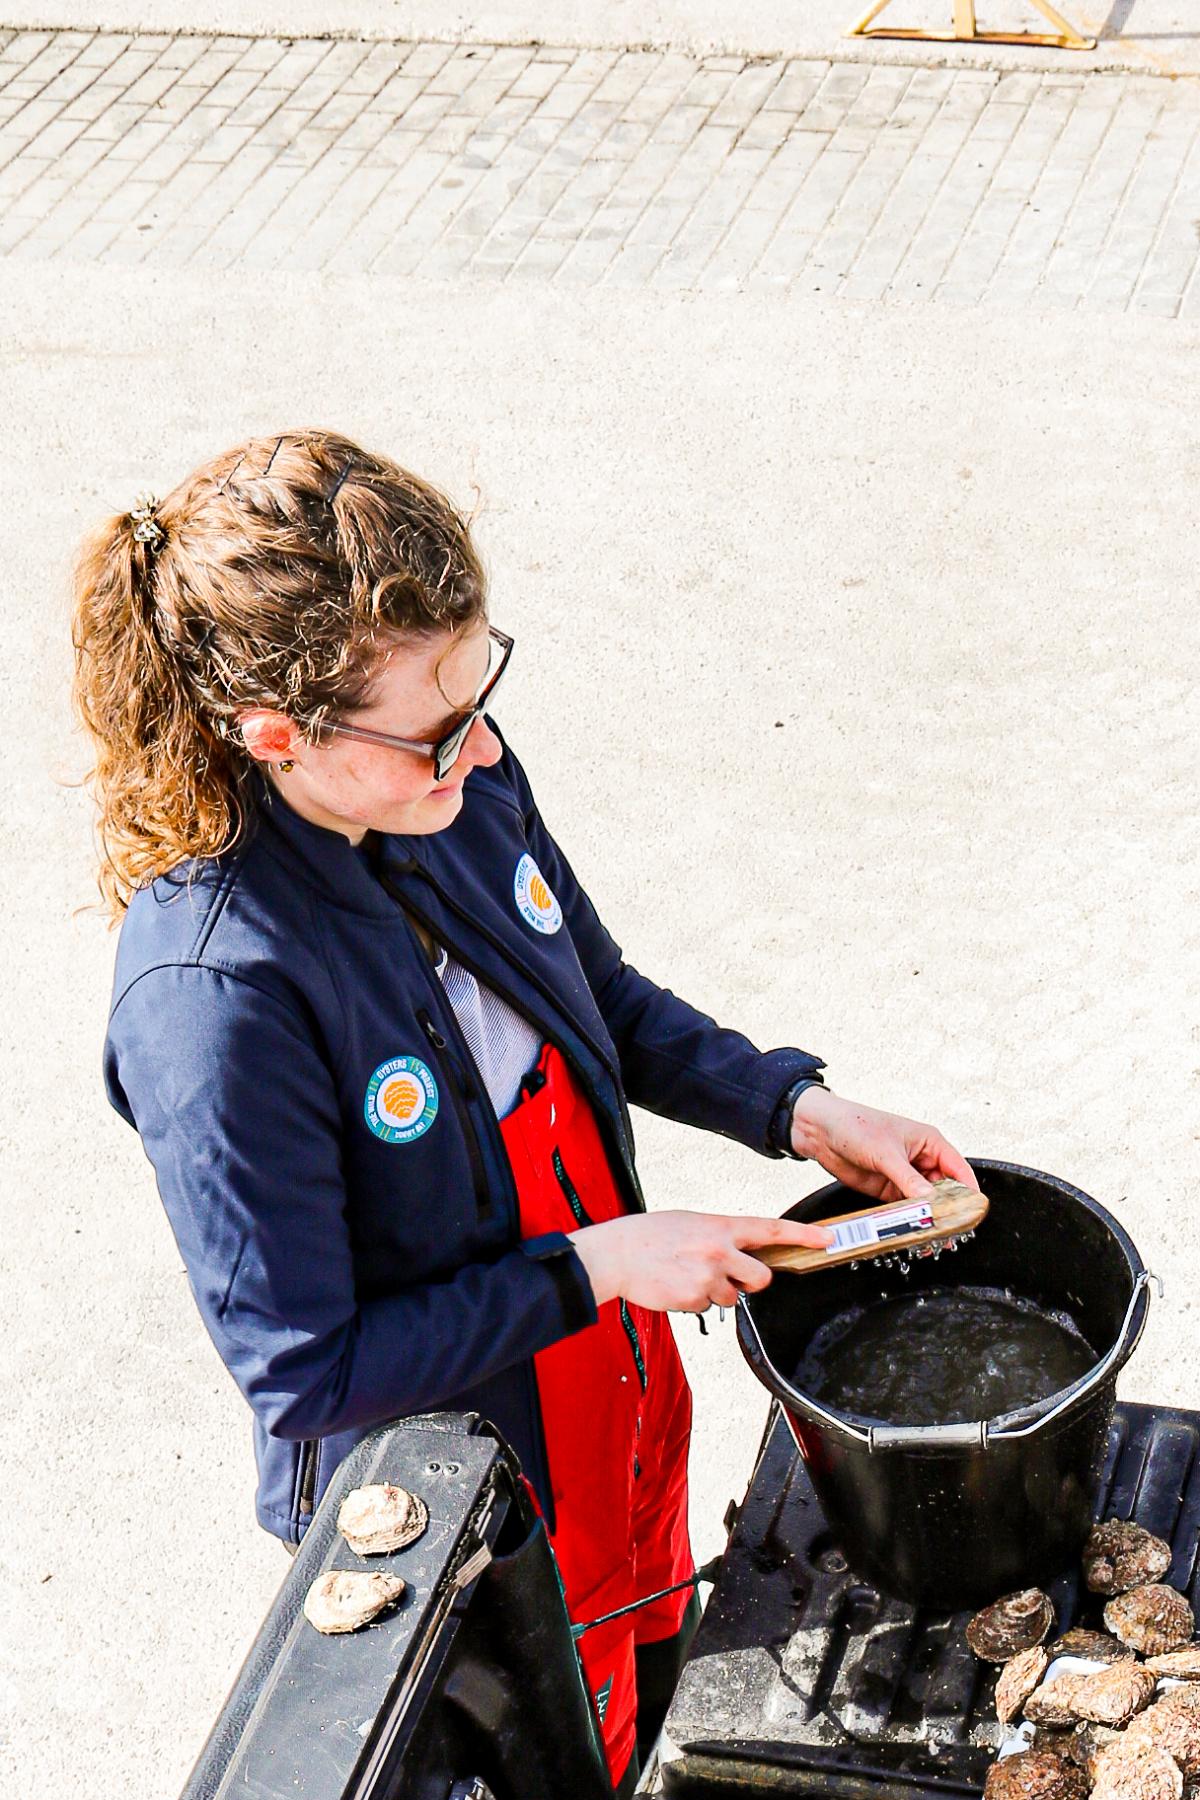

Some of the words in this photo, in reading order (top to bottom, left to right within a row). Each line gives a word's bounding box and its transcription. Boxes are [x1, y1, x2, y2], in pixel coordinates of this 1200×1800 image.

[376, 1059, 407, 1080] OYSTERS
[418, 1069, 435, 1098] PROJECT
[367, 1095, 376, 1113] WILD
[368, 1112, 380, 1128] THE
